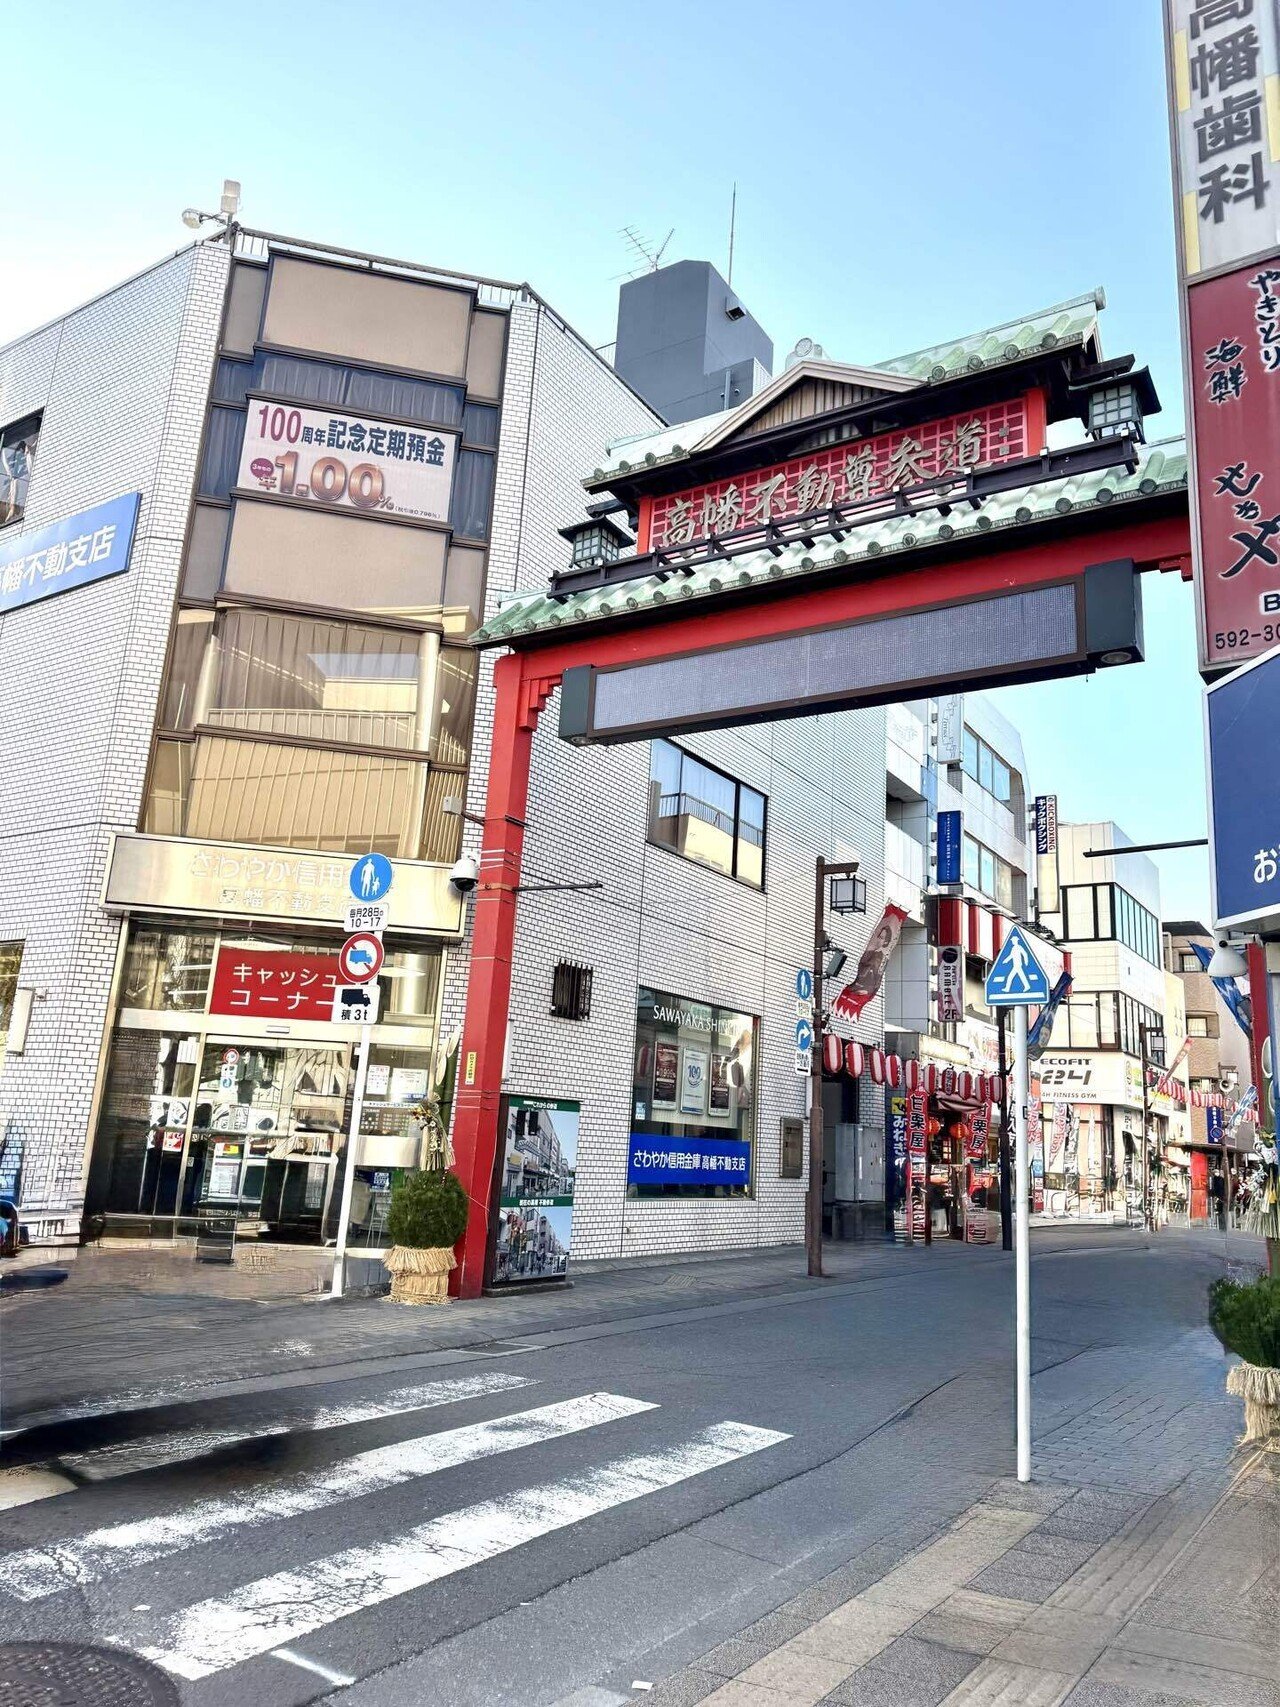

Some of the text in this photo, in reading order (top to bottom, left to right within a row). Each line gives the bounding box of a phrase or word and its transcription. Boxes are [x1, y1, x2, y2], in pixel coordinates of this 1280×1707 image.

[1204, 338, 1246, 404] 海鮮
[232, 962, 337, 988] キャッシュ
[229, 988, 335, 1010] コーナー
[653, 1004, 704, 1029] SAWAYAKA
[944, 1008, 957, 1020] 2F
[1040, 1058, 1092, 1066] ECOFIT
[633, 1149, 746, 1171] さわやか信用金庫 高幡不動支店
